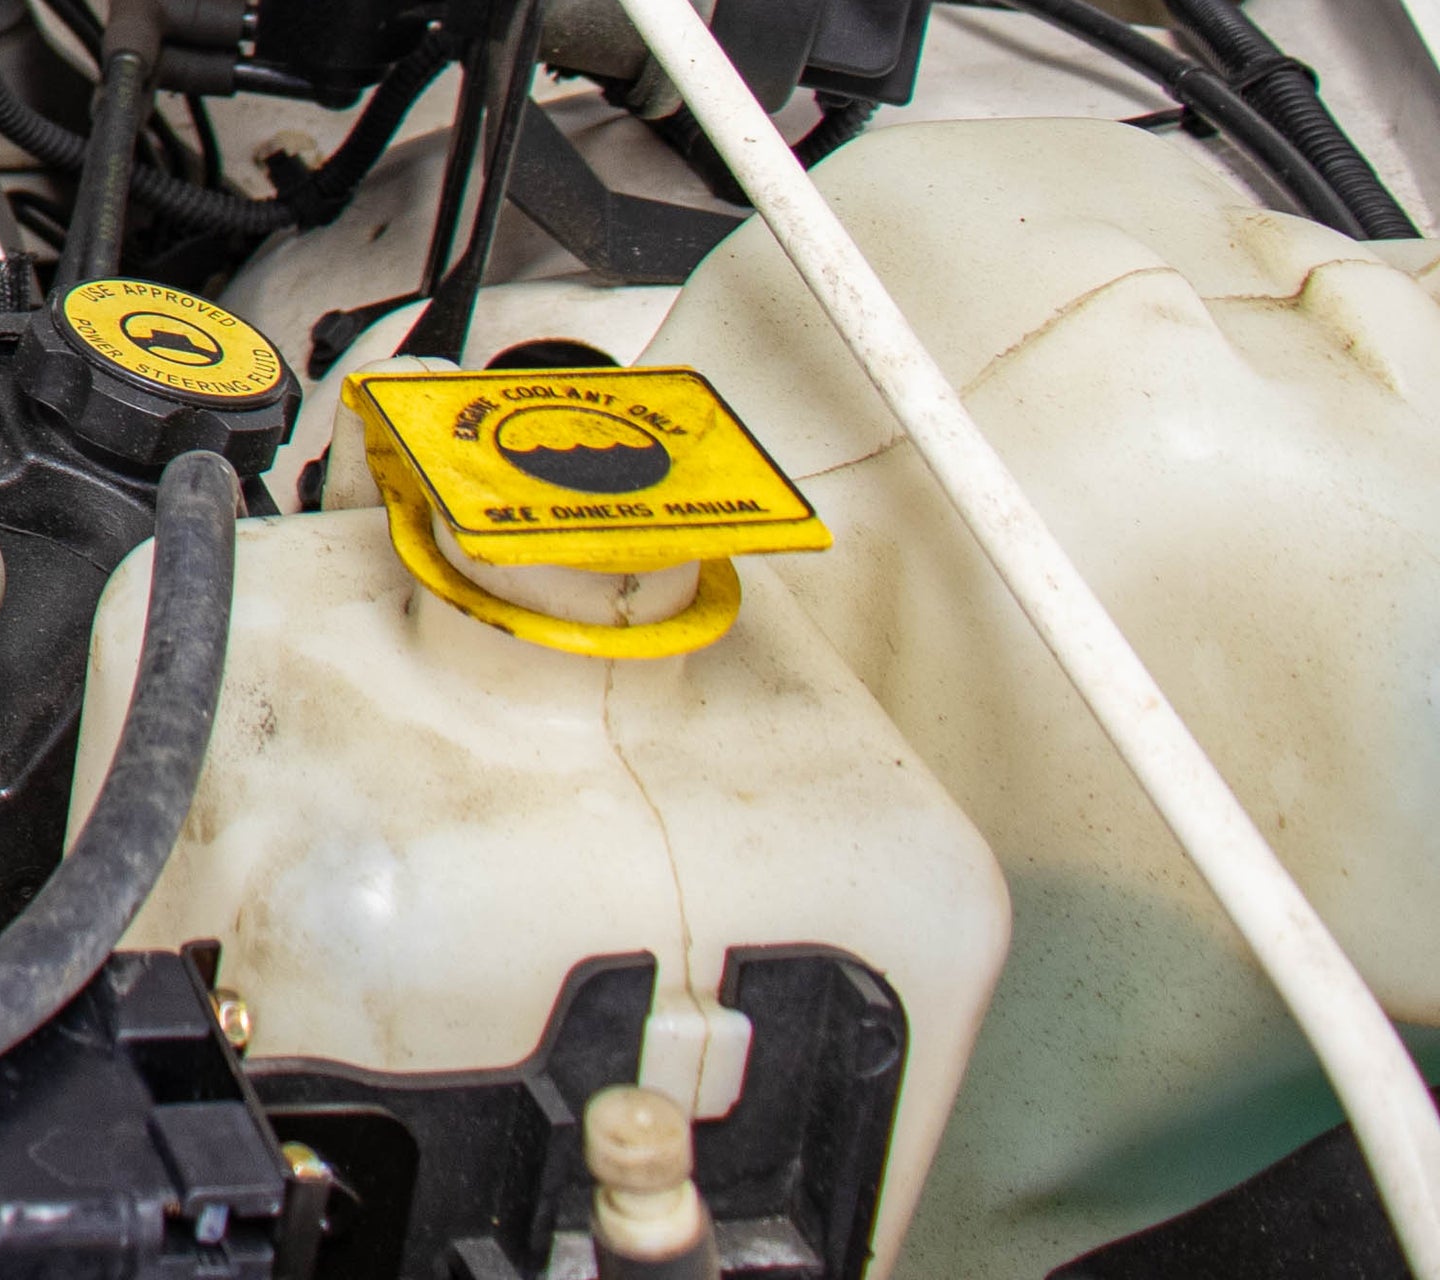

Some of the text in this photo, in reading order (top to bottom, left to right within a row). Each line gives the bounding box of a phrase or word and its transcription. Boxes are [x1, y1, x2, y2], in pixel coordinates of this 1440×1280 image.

[80, 283, 237, 328] USE APPROVED
[71, 316, 277, 394] POWER STEERING FLUID
[454, 385, 688, 442] ENGINE COOLANT ONLY
[484, 499, 771, 523] SEE OWNERS MANUAL
